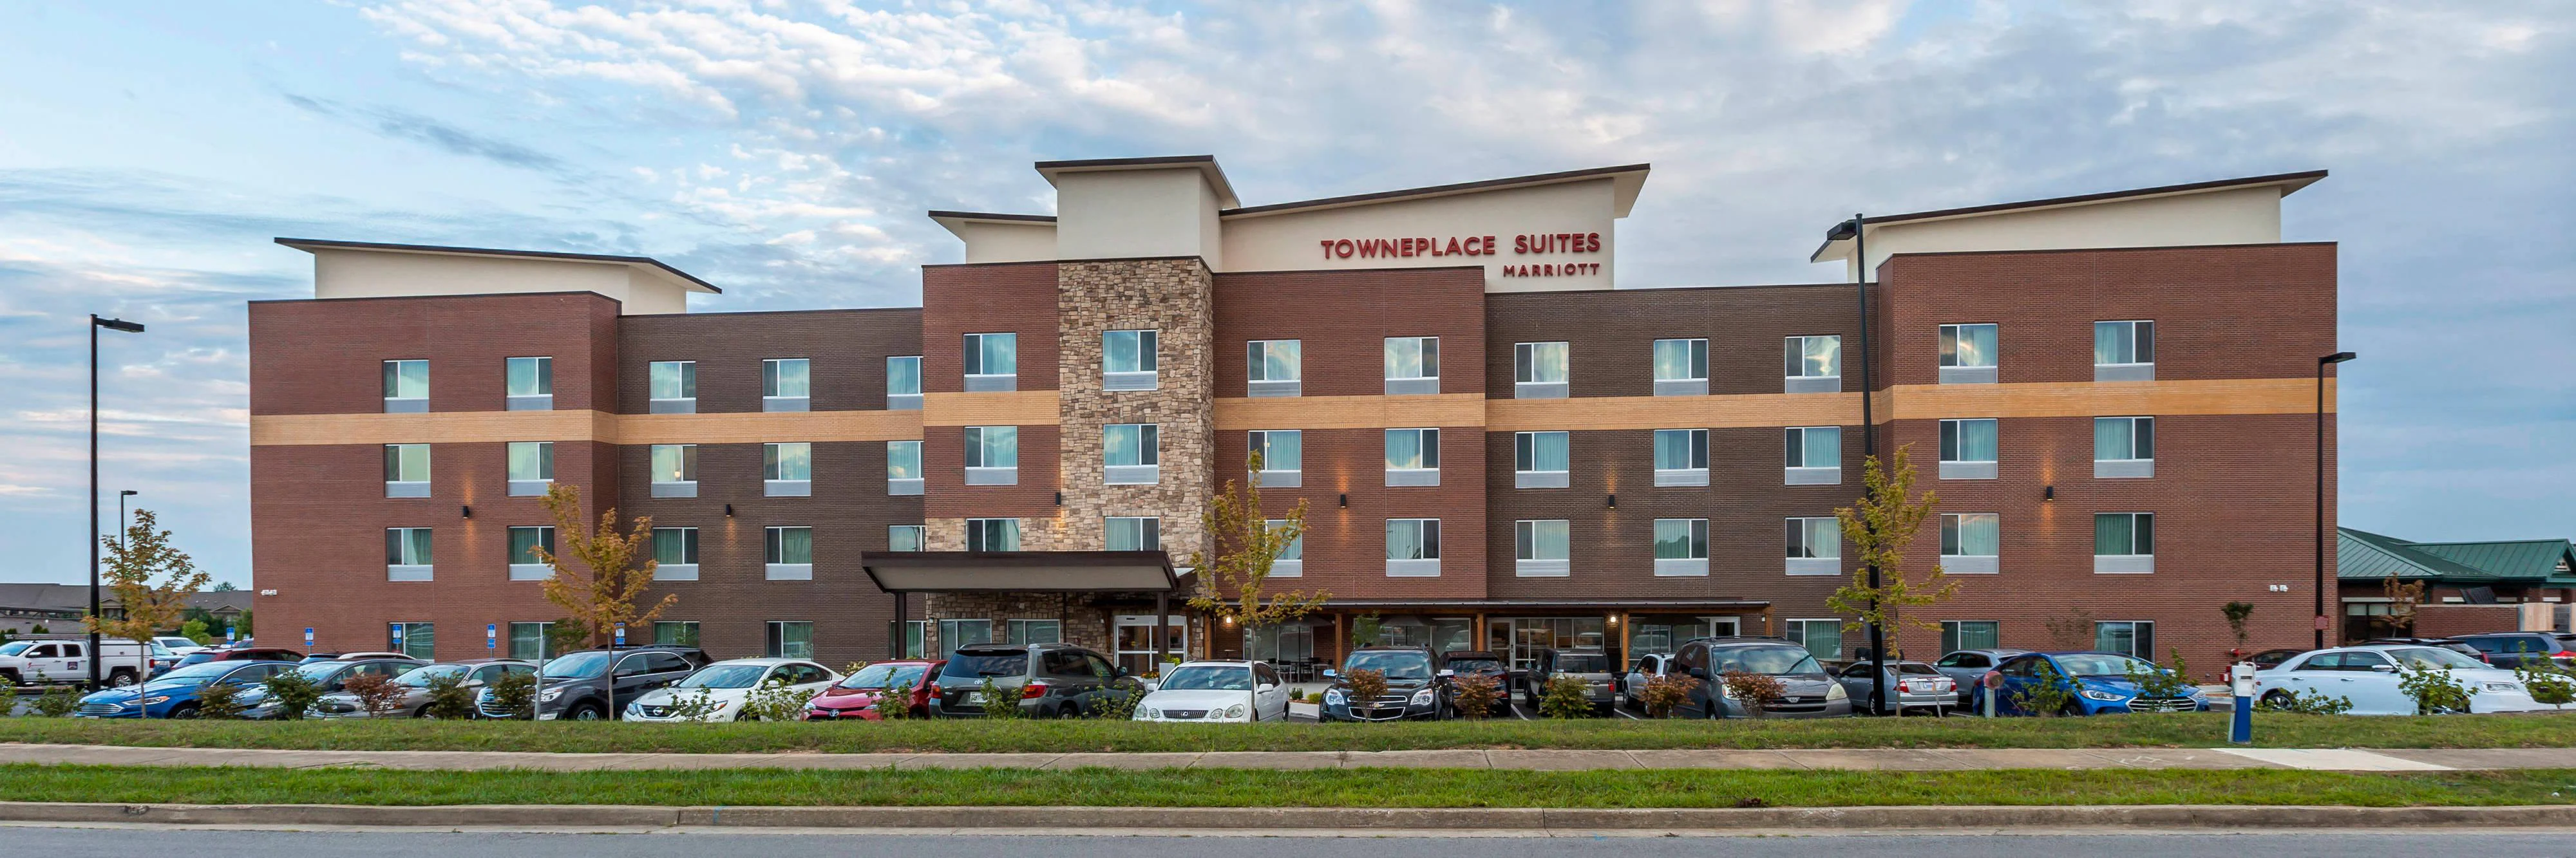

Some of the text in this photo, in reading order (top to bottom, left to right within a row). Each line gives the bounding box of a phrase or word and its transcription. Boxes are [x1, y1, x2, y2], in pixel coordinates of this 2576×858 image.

[1320, 232, 1602, 259] TOWNEPLACE SUITES
[1503, 263, 1600, 277] MARRIOTT
